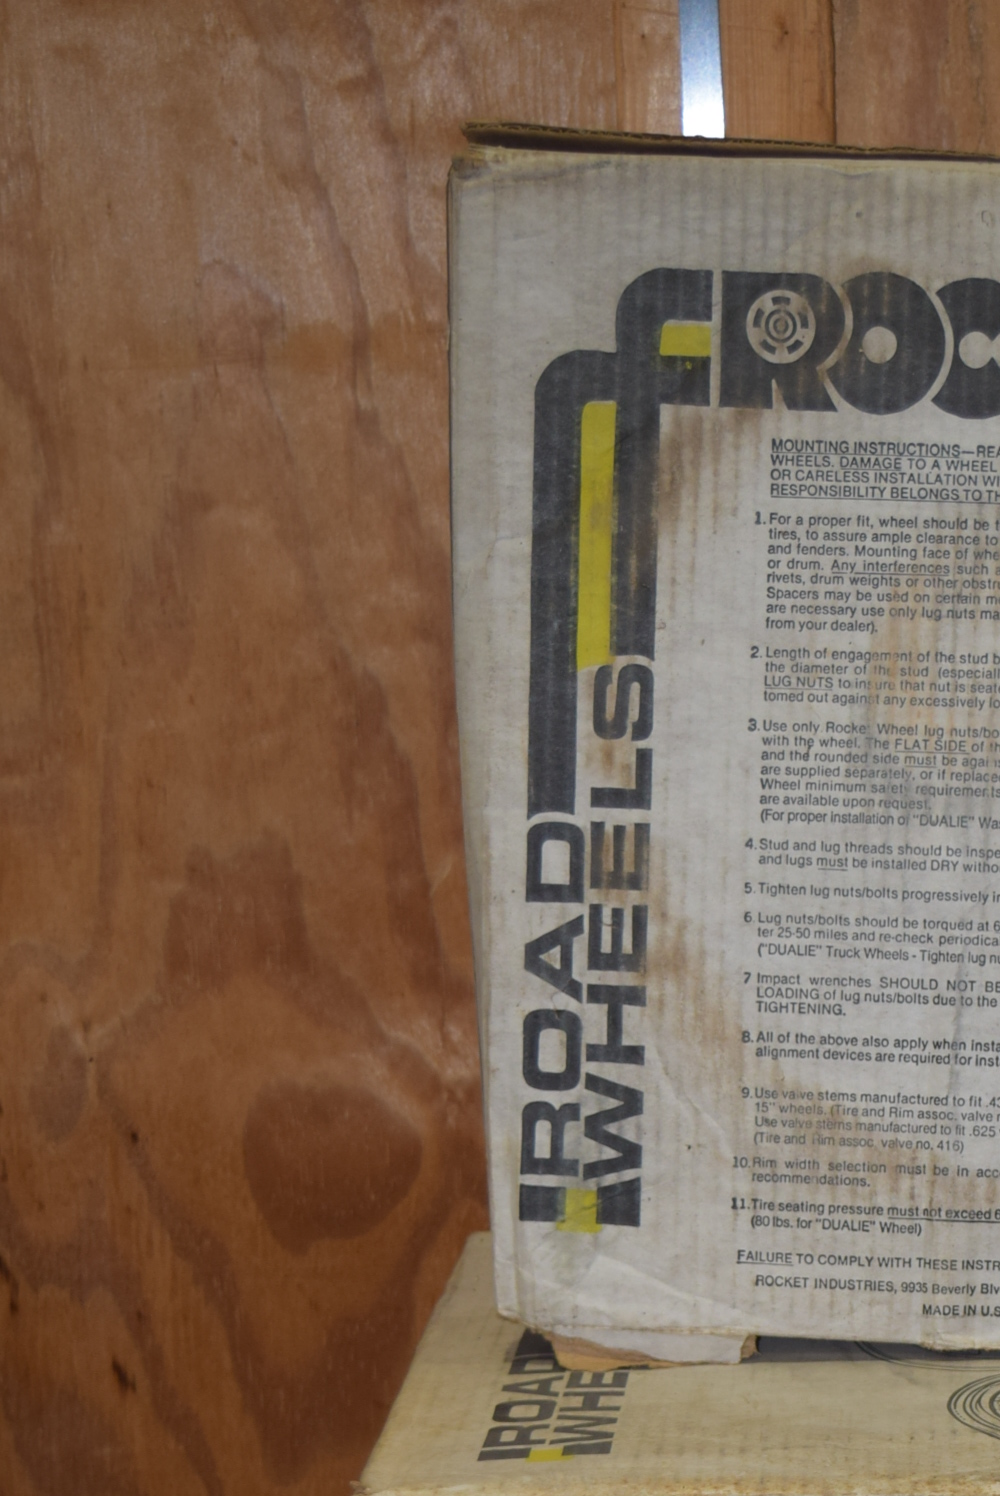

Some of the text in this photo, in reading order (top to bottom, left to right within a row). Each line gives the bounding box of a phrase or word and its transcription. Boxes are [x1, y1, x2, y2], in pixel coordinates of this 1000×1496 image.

[771, 438, 849, 453] MOUNTING
[770, 455, 835, 467] WHEELS.
[839, 456, 901, 469] DAMAGE
[908, 458, 926, 470] TO
[931, 459, 940, 470] A
[945, 459, 996, 472] WHEEL
[769, 469, 791, 481] OR
[795, 469, 869, 483] CARELESS
[874, 472, 977, 486] INSTALLATION
[769, 484, 885, 499] RESPONSIBILITY
[890, 488, 960, 502] BELONGS
[965, 491, 983, 503] TO
[768, 528, 800, 542] tires,
[805, 529, 819, 541] to
[822, 532, 867, 542] assure
[871, 531, 911, 546] ample
[916, 532, 980, 545] clearance
[985, 534, 998, 546] to
[758, 853, 782, 865] and
[785, 854, 813, 868] lugs
[816, 855, 848, 867] must
[852, 856, 868, 868] be
[871, 857, 927, 870] installed
[930, 859, 959, 872] DRY
[758, 882, 806, 898] Tighten
[809, 884, 830, 898] lug
[833, 885, 898, 901] nuts/bolts
[901, 888, 989, 905] progressively
[583, 662, 655, 1179] WHEELS
[757, 973, 800, 988] Impact
[809, 975, 871, 988] wrenches
[879, 977, 939, 991] SHOULD
[946, 980, 975, 992] NOT
[521, 821, 585, 1176] ROAD
[756, 1001, 846, 1015] TIGHTENING.
[755, 1046, 819, 1062] alignment
[822, 1048, 872, 1062] devices
[874, 1053, 895, 1063] are
[897, 1051, 950, 1067] required
[953, 1053, 972, 1065] for
[737, 1250, 792, 1263] FAILURE
[795, 1252, 814, 1264] TO
[817, 1253, 874, 1266] COMPLY
[877, 1255, 912, 1268] WITH
[916, 1257, 958, 1270] THESE
[753, 1275, 807, 1289] ROCKET
[813, 1278, 897, 1294] INDUSTRIES,
[900, 1281, 928, 1293] 9935
[931, 1282, 976, 1297] Beverly
